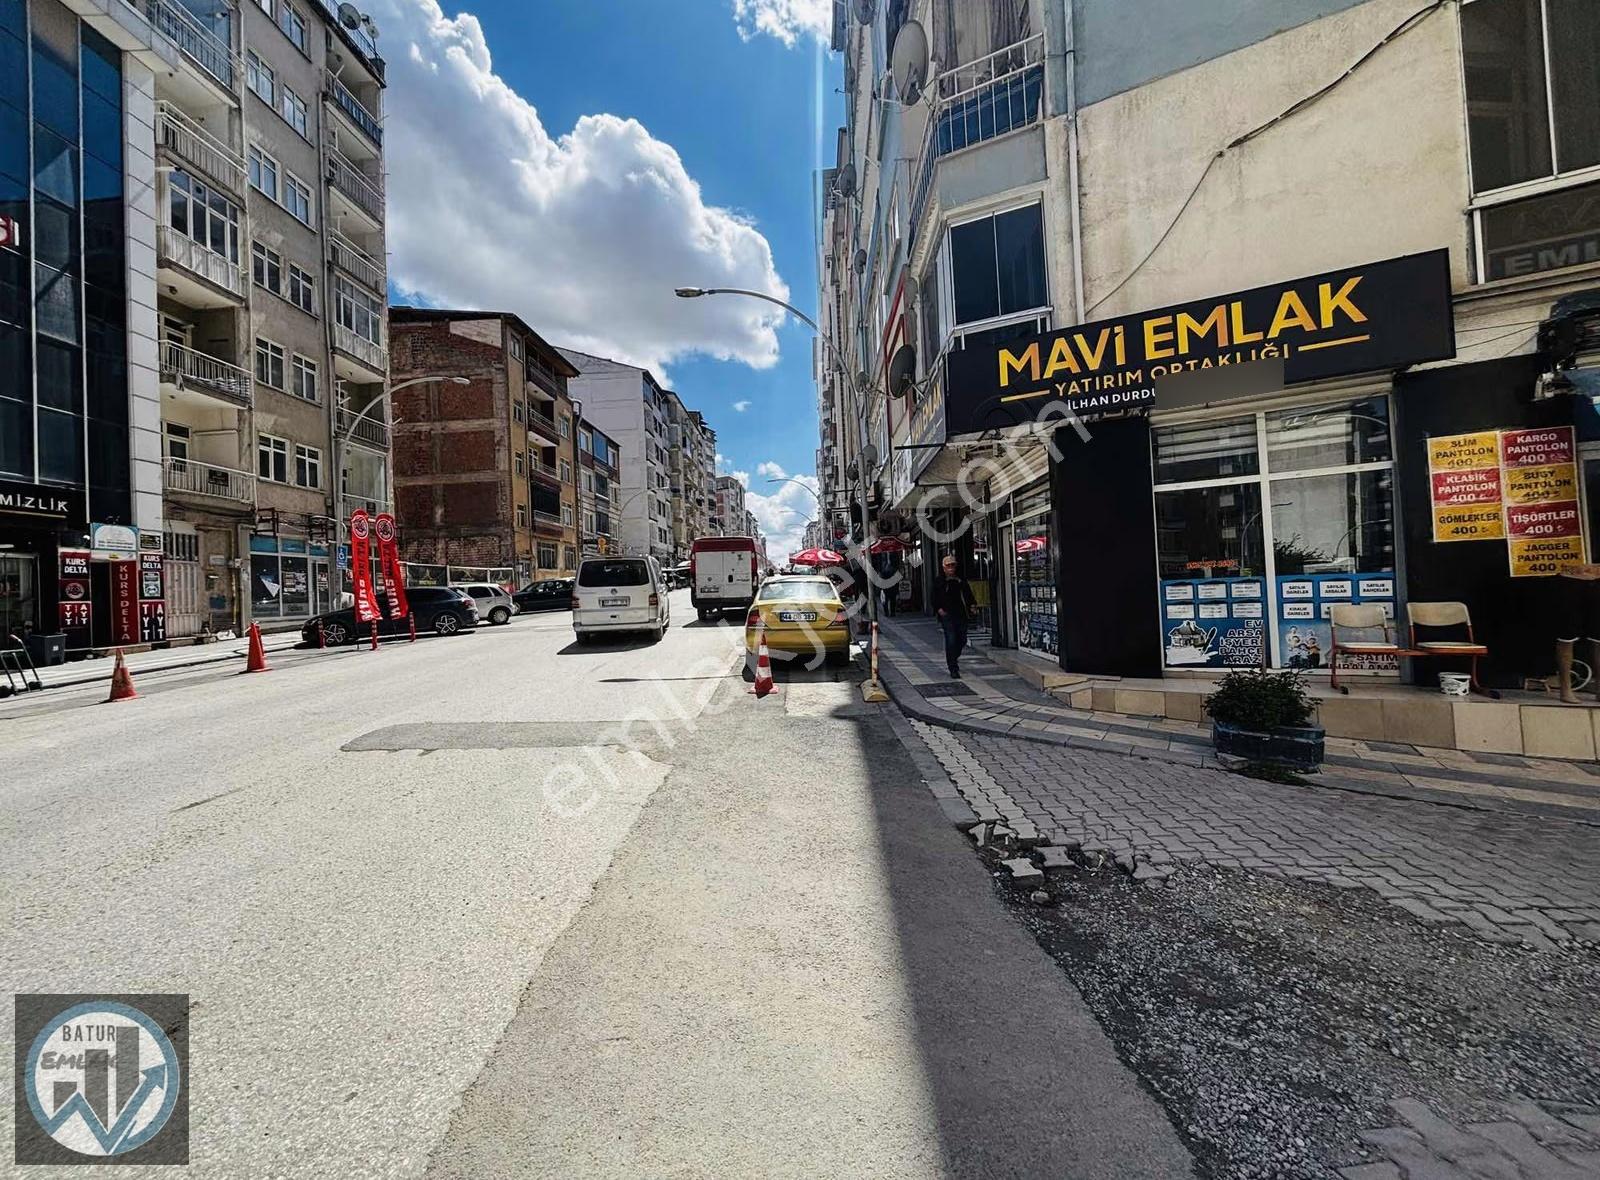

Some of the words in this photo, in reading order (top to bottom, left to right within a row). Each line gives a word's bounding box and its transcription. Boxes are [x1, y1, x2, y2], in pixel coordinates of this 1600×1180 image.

[998, 325, 1126, 387] MAVİ
[1143, 276, 1369, 361] EMLAK
[1055, 369, 1143, 397] YATIRIM
[1517, 433, 1557, 443] KARGO
[1507, 442, 1568, 453] PANTOLON
[1436, 447, 1494, 458] PANTOLON
[1519, 454, 1545, 463] 400
[1447, 473, 1487, 483] KLASİK
[1438, 482, 1496, 494] PANTOLON
[1511, 479, 1571, 490] PANTOLON
[1450, 494, 1475, 502] 400
[1451, 526, 1477, 534] 400
[1525, 525, 1553, 534] 400
[1524, 543, 1569, 551] JAGGER
[65, 558, 87, 566] KURS
[1517, 553, 1578, 562] PANTOLON
[64, 566, 88, 574] DELTA
[1529, 563, 1556, 571] 400
[120, 565, 129, 597] KURS
[120, 601, 131, 640] DELTA
[142, 604, 150, 640] TYT
[156, 604, 165, 639] AYT
[1245, 620, 1263, 628] EV
[1227, 629, 1262, 637] ARSA
[1224, 656, 1263, 664] ARAZ
